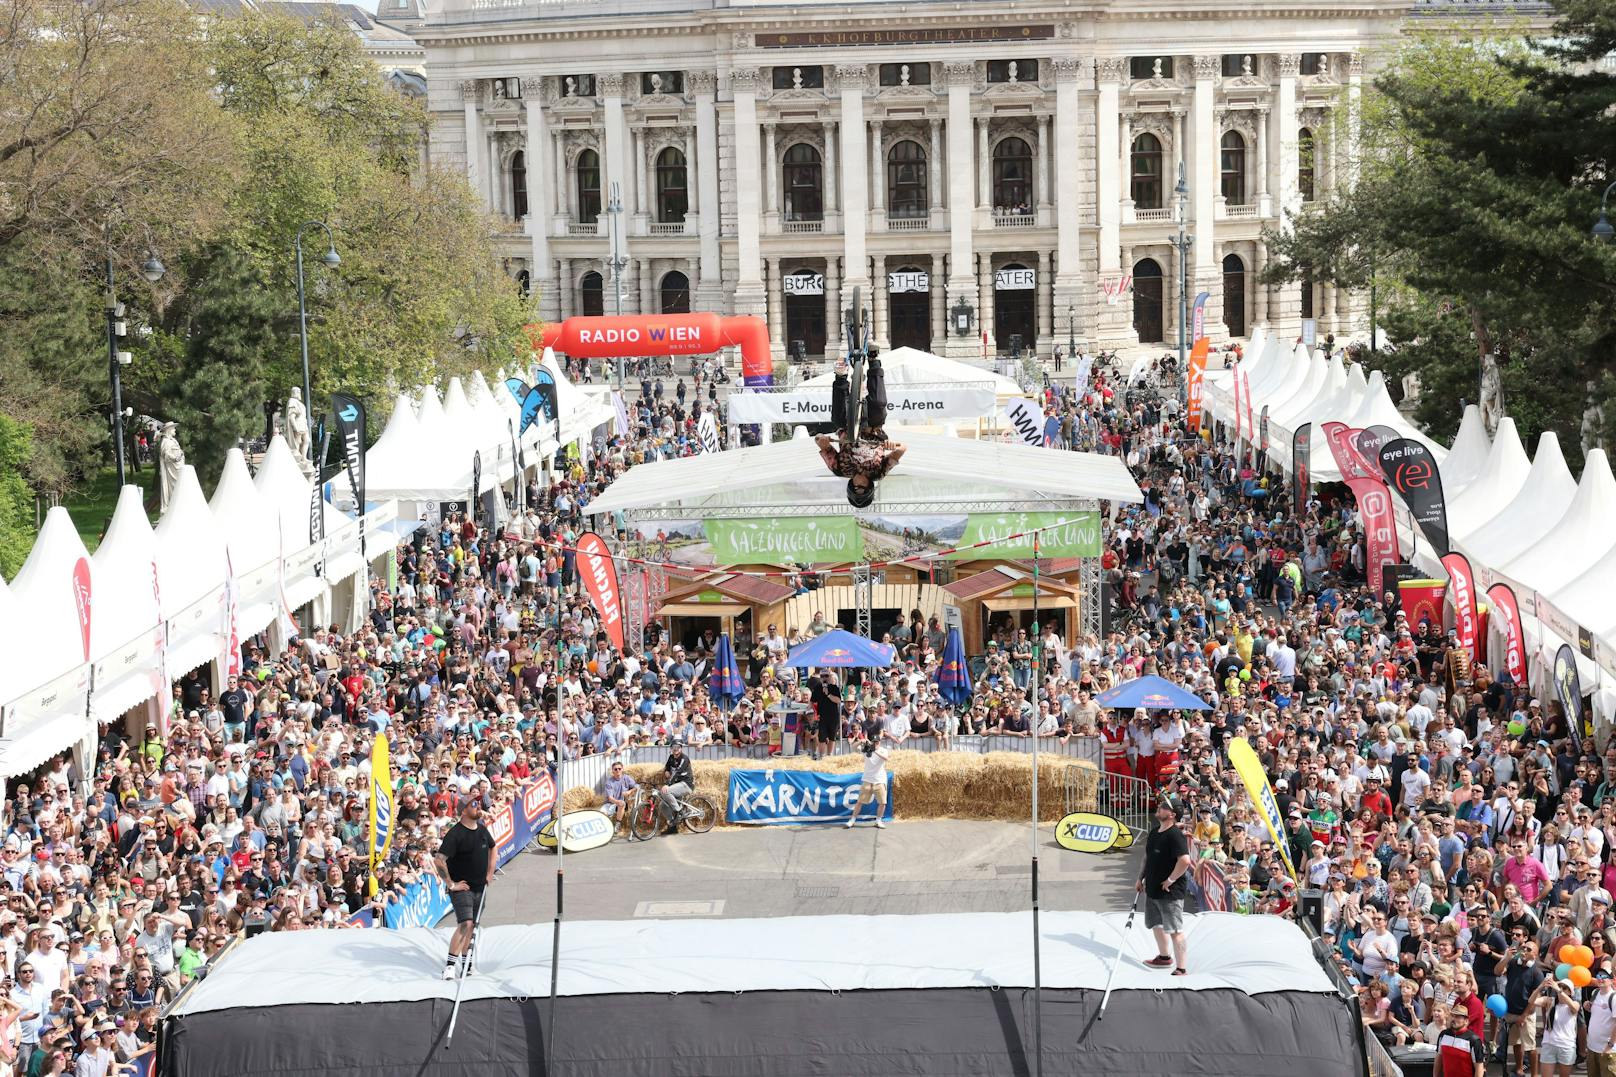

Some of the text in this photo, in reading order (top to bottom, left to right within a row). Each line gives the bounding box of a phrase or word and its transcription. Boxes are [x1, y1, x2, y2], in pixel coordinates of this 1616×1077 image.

[579, 326, 701, 343] RADIO WIEN
[732, 769, 877, 816] KÄRNTE
